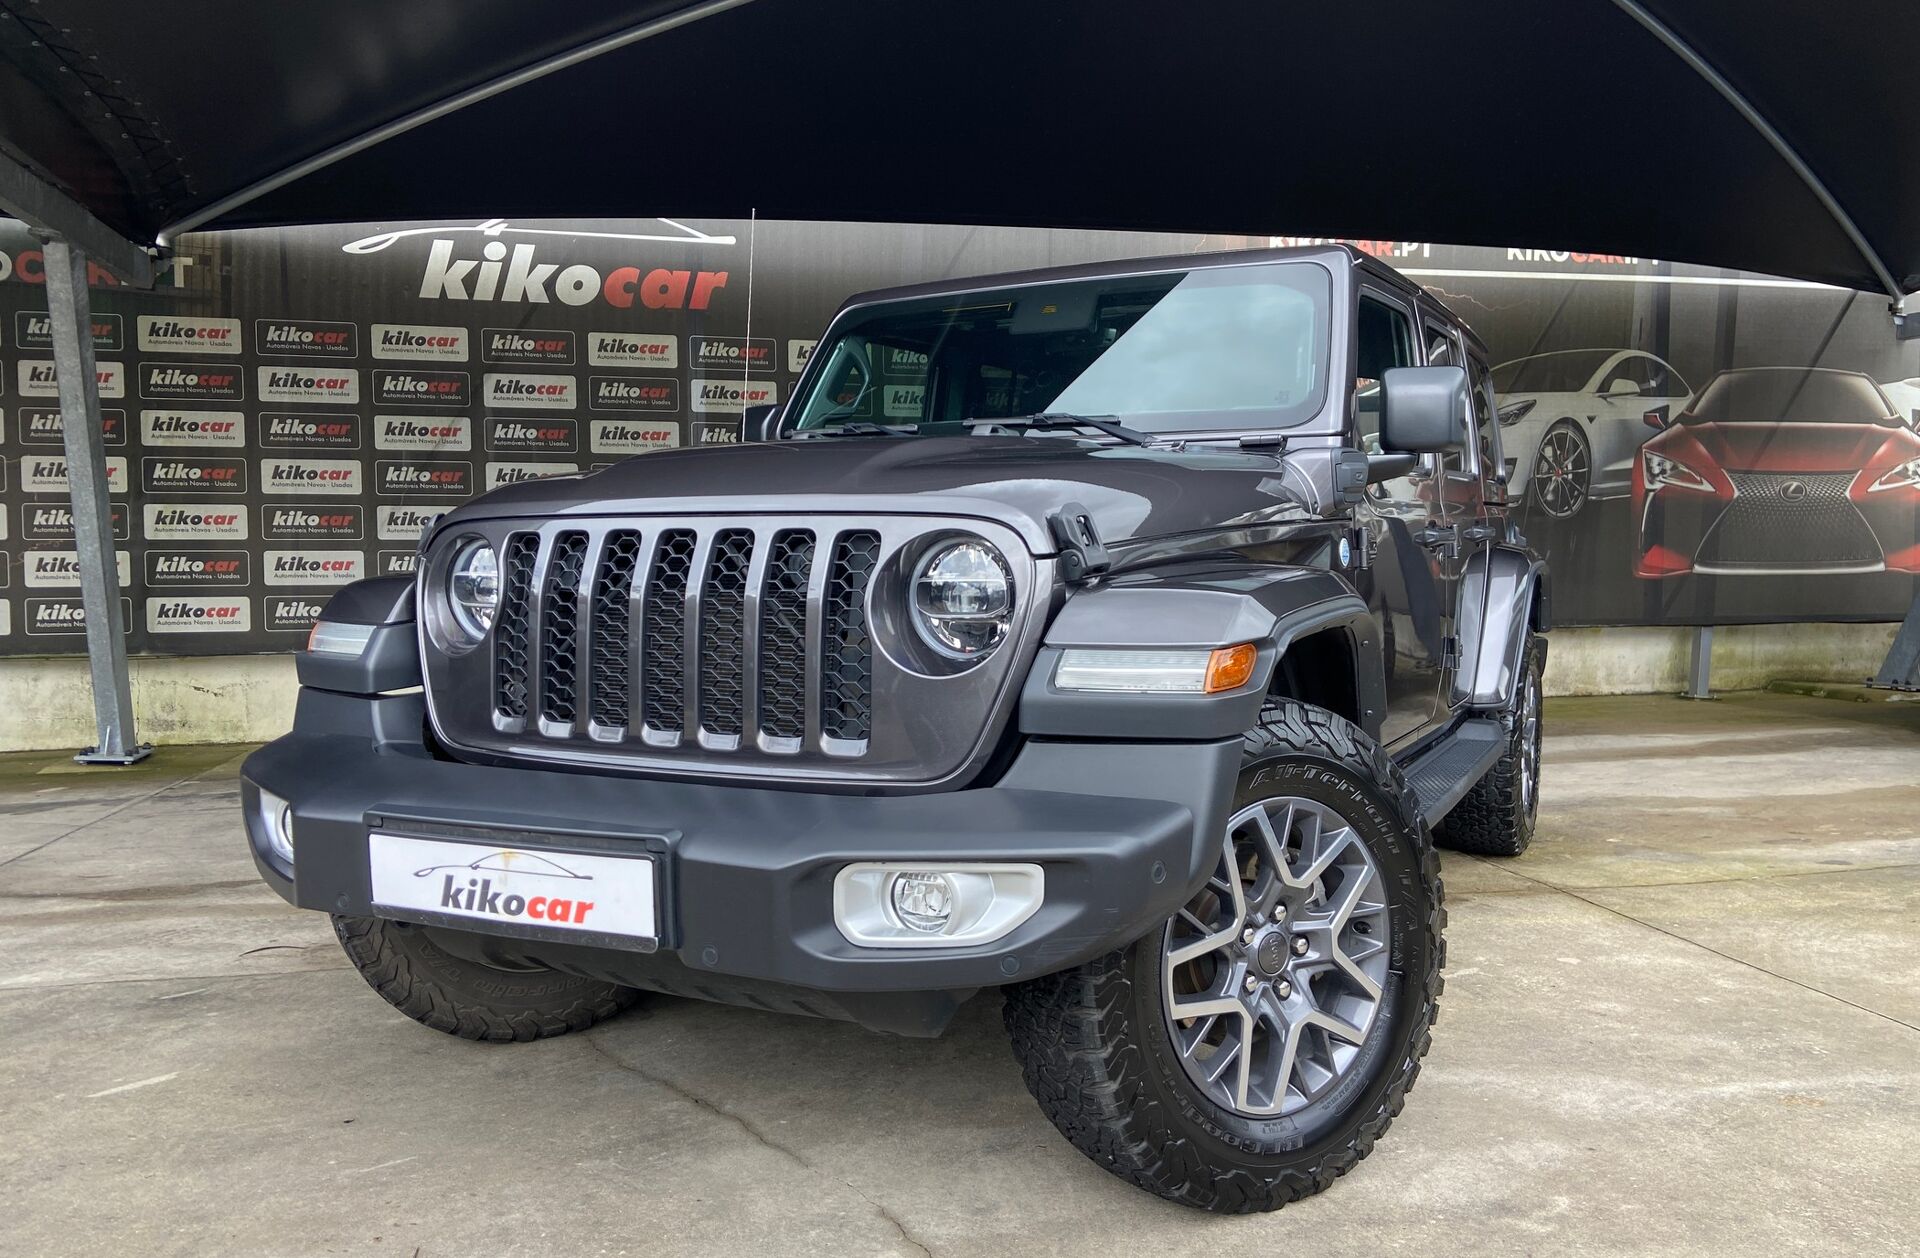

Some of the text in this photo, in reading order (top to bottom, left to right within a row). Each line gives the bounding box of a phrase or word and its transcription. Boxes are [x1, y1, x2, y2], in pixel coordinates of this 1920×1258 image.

[418, 239, 729, 310] kikocar
[149, 322, 231, 339] kikocar
[267, 326, 347, 343] kikocar
[382, 330, 459, 347] kikocar
[492, 334, 566, 351] kikocar
[598, 338, 668, 355] kikocar
[150, 369, 233, 386] kikocar
[269, 373, 348, 389] kikocar
[383, 376, 460, 393] kikocar
[494, 380, 567, 396] kikocar
[599, 382, 670, 398] kikocar
[152, 417, 234, 433] kikocar
[270, 418, 350, 435] kikocar
[385, 421, 462, 437] kikocar
[494, 424, 568, 439] kikocar
[600, 426, 670, 441] kikocar
[153, 464, 236, 479] kikocar
[272, 465, 352, 480] kikocar
[386, 467, 463, 482] kikocar
[155, 511, 237, 525] kikocar
[273, 511, 353, 526] kikocar
[156, 557, 239, 572] kikocar
[275, 557, 354, 571] kikocar
[158, 604, 240, 618] kikocar
[441, 874, 594, 924] kikocar
